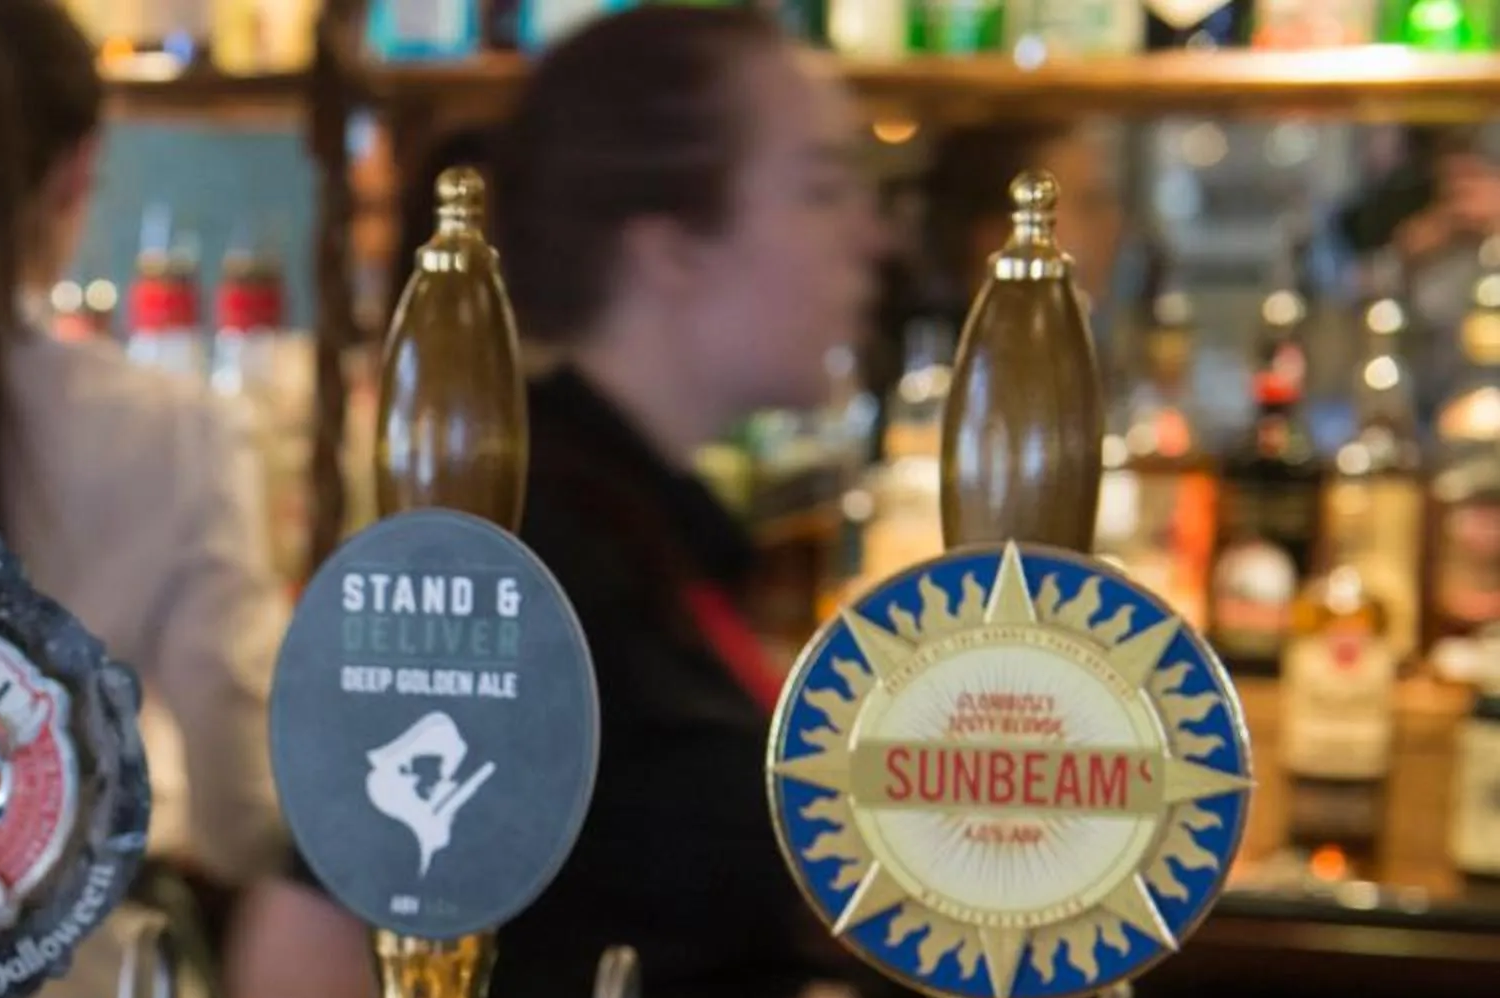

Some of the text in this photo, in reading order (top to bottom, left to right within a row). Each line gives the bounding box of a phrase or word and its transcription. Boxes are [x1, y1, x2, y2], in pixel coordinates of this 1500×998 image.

[342, 573, 522, 617] STAND &
[342, 616, 523, 658] DELIVER
[339, 665, 518, 699] DEEP GOLDEN ALE
[884, 745, 1130, 811] SUNBEAM
